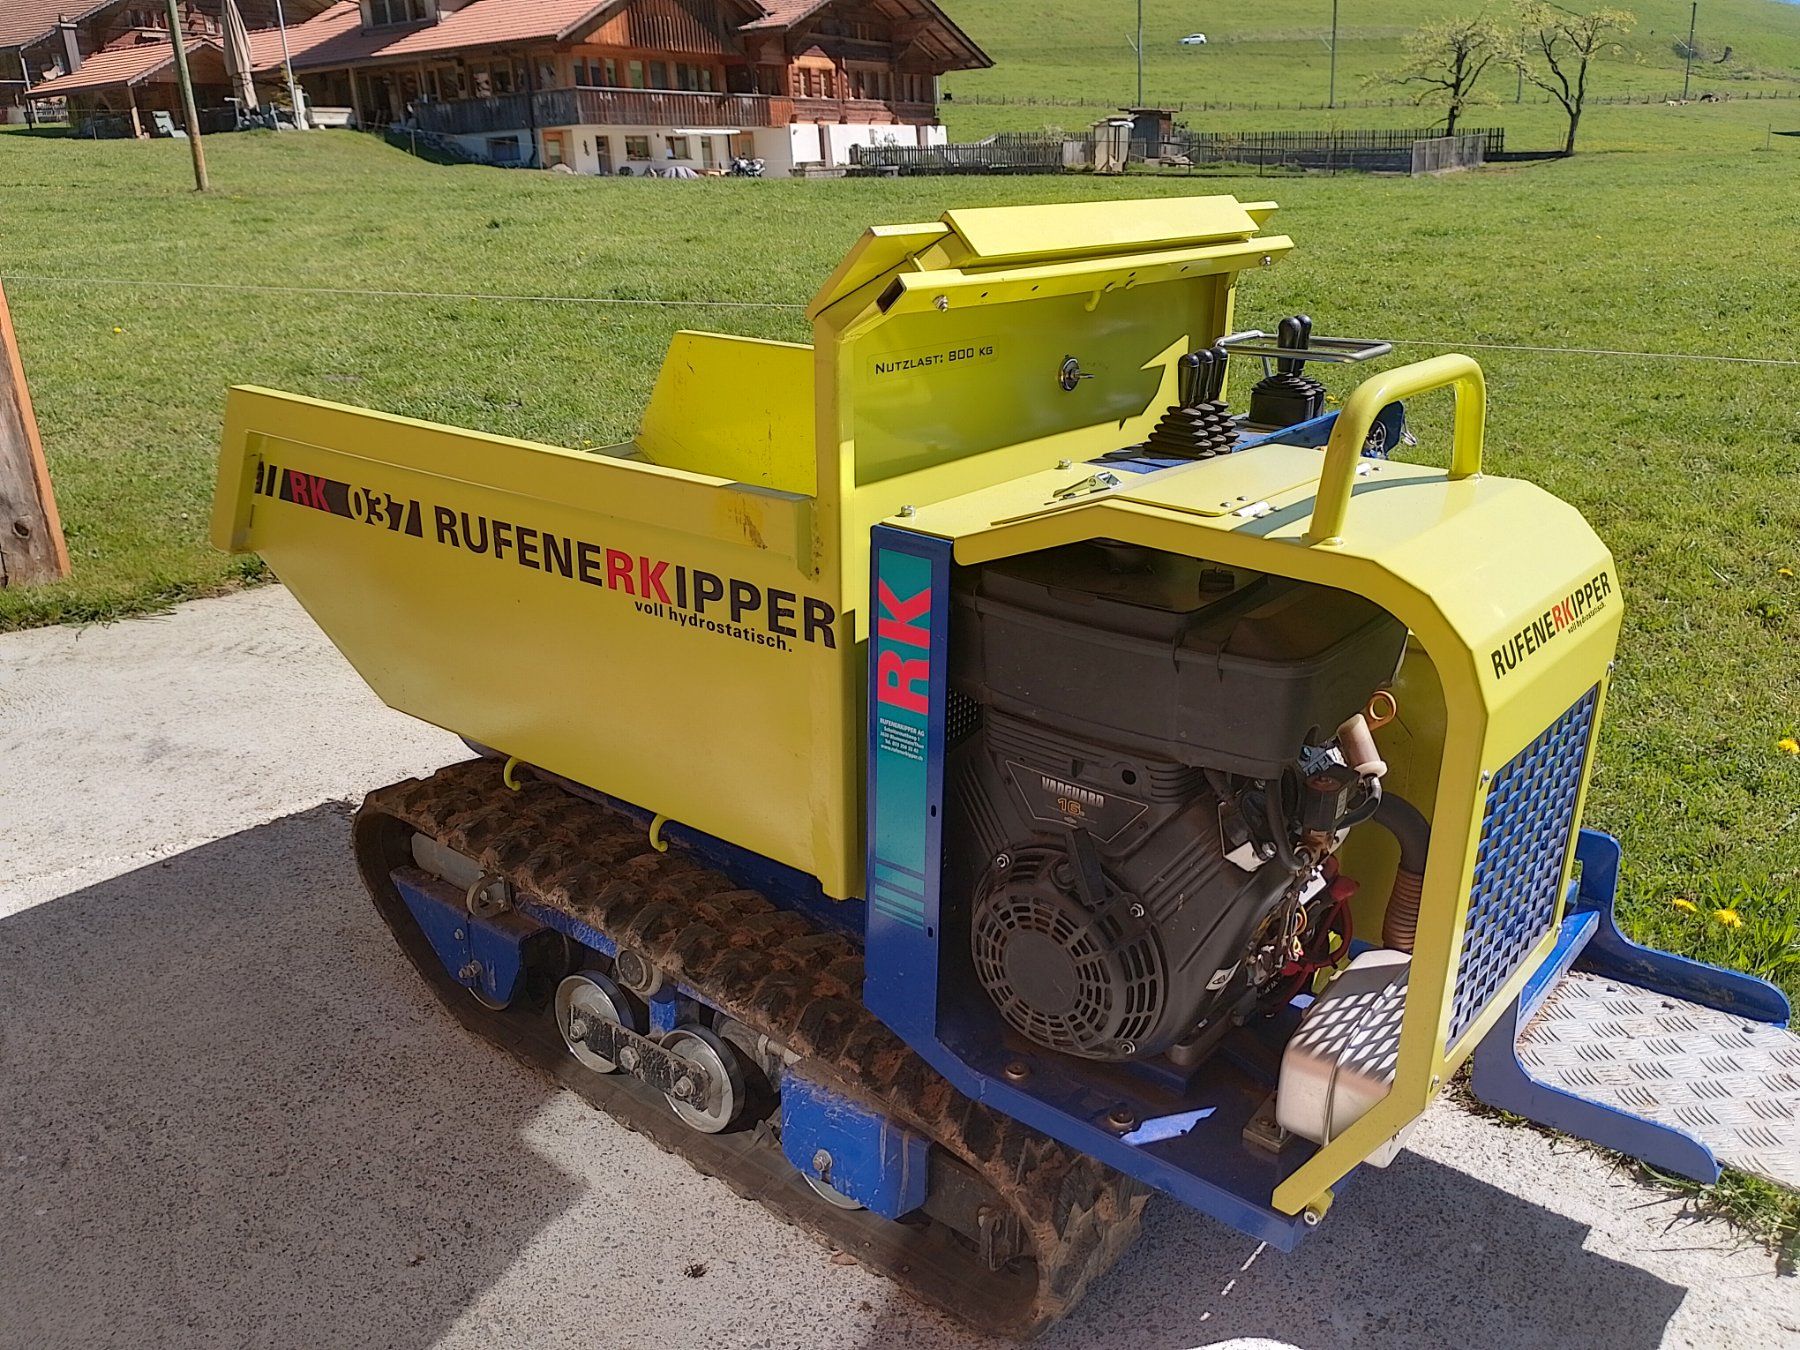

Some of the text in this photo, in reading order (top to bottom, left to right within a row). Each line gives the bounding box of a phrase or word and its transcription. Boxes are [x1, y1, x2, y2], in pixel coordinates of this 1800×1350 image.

[875, 345, 994, 375] NUTZLAST: 800 KG
[289, 469, 331, 513] RK
[434, 504, 837, 650] RUFENERKIPPER
[634, 600, 793, 653] voll hydrostatisch.
[877, 576, 931, 716] RK
[1490, 571, 1612, 680] RUFENERKIPPER
[1041, 775, 1105, 809] VANGUARD
[1057, 797, 1081, 817] 16
